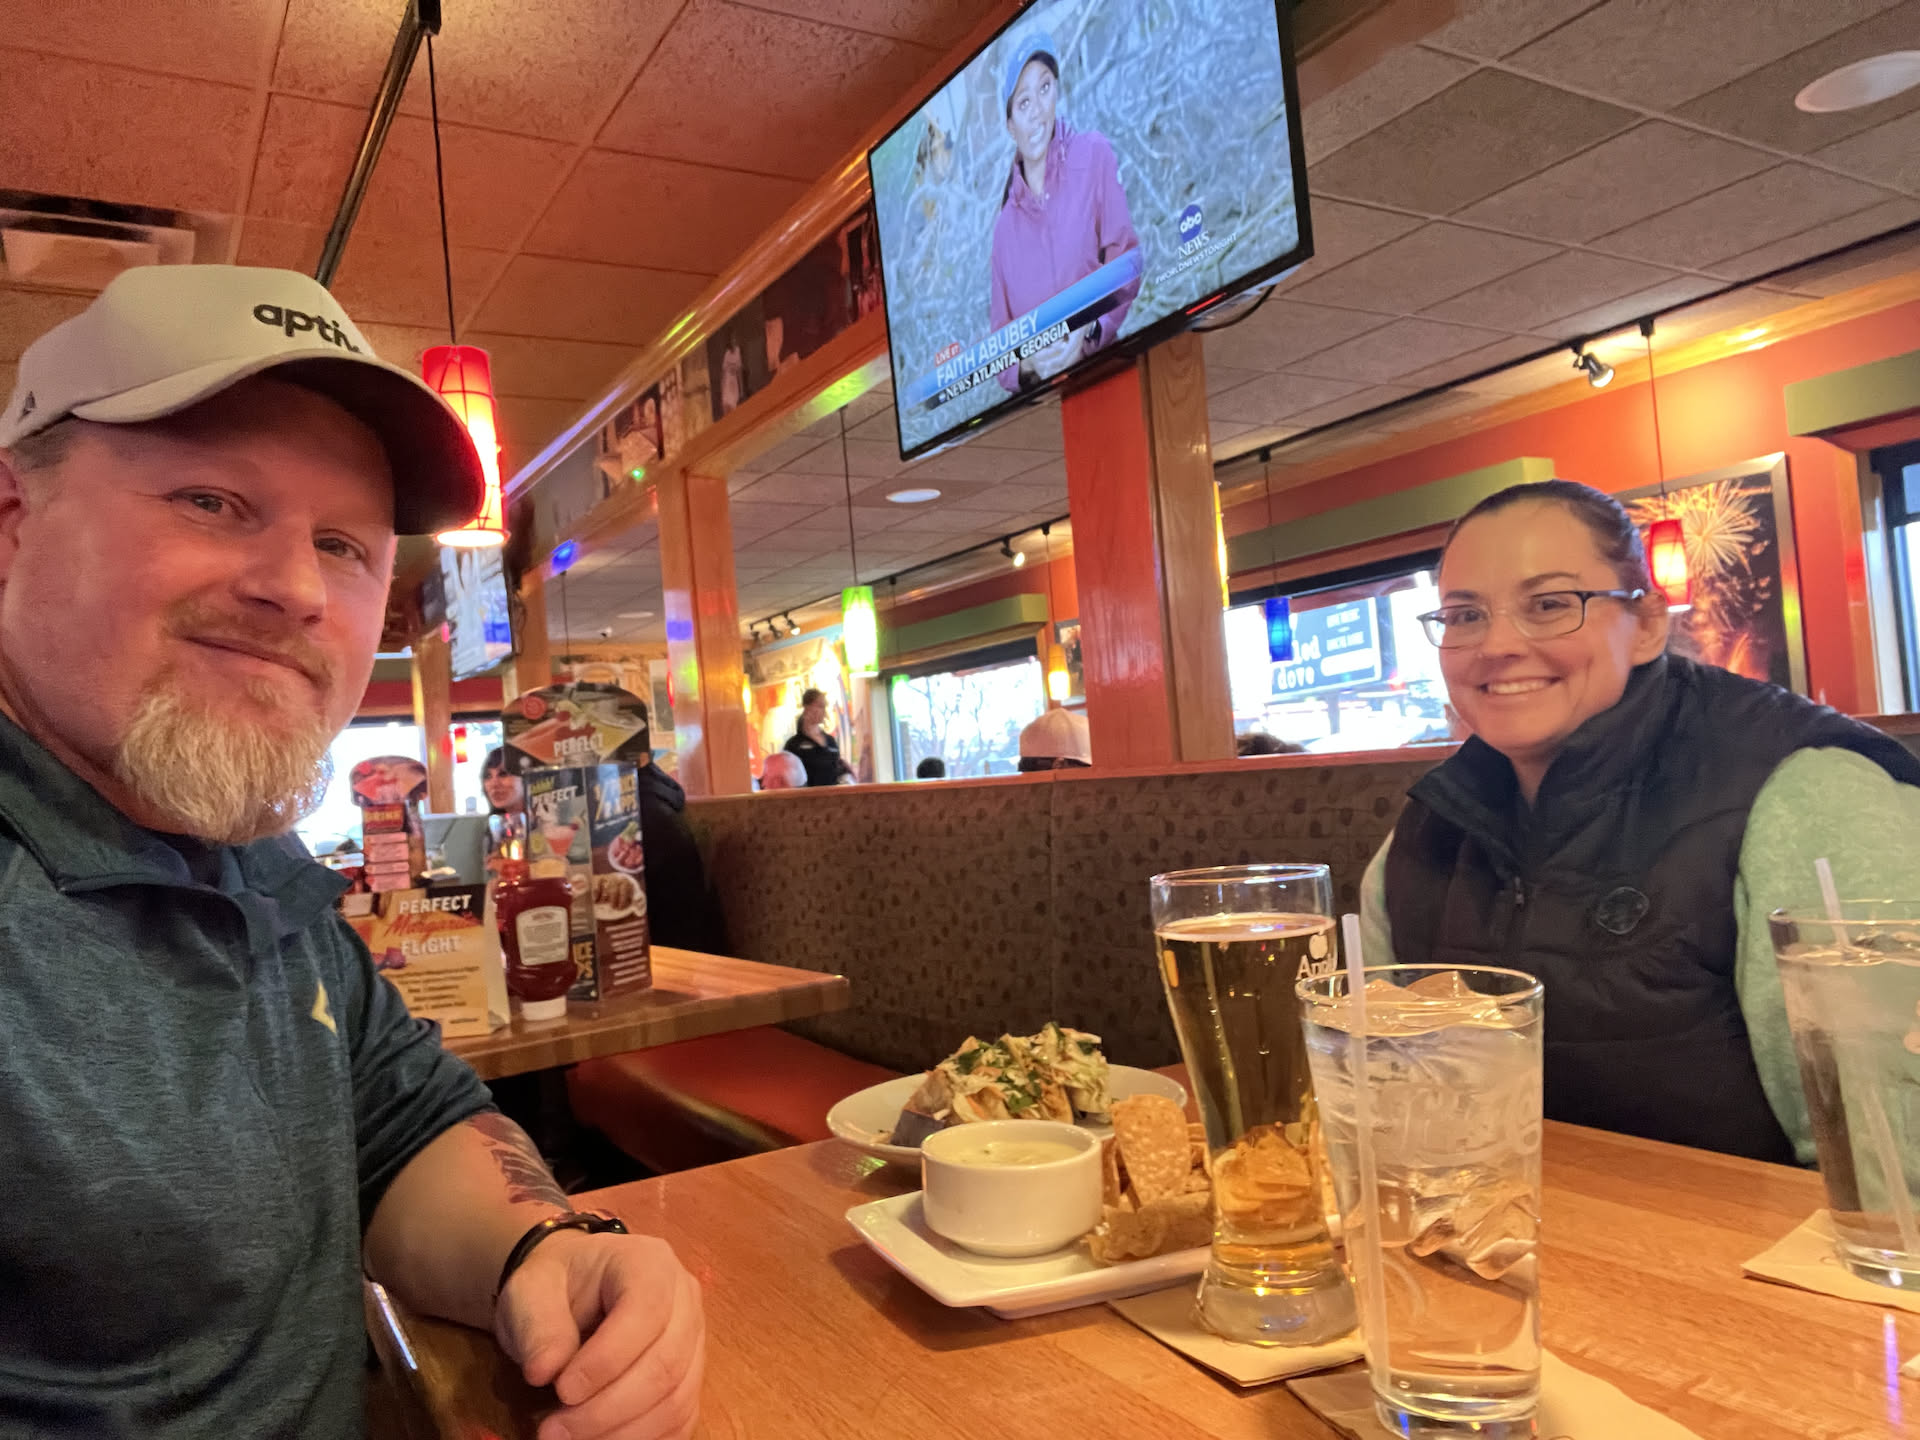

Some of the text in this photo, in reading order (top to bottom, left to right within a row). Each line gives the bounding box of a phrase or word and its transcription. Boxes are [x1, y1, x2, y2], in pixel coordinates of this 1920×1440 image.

[1180, 211, 1202, 233] abc
[1178, 231, 1210, 259] NEWS
[936, 309, 1039, 388] FAITH ABUBEY
[945, 376, 972, 401] NEWS
[1020, 320, 1070, 358] GEORGIA
[399, 894, 473, 914] PERFECT
[401, 935, 461, 957] FLIGHT
